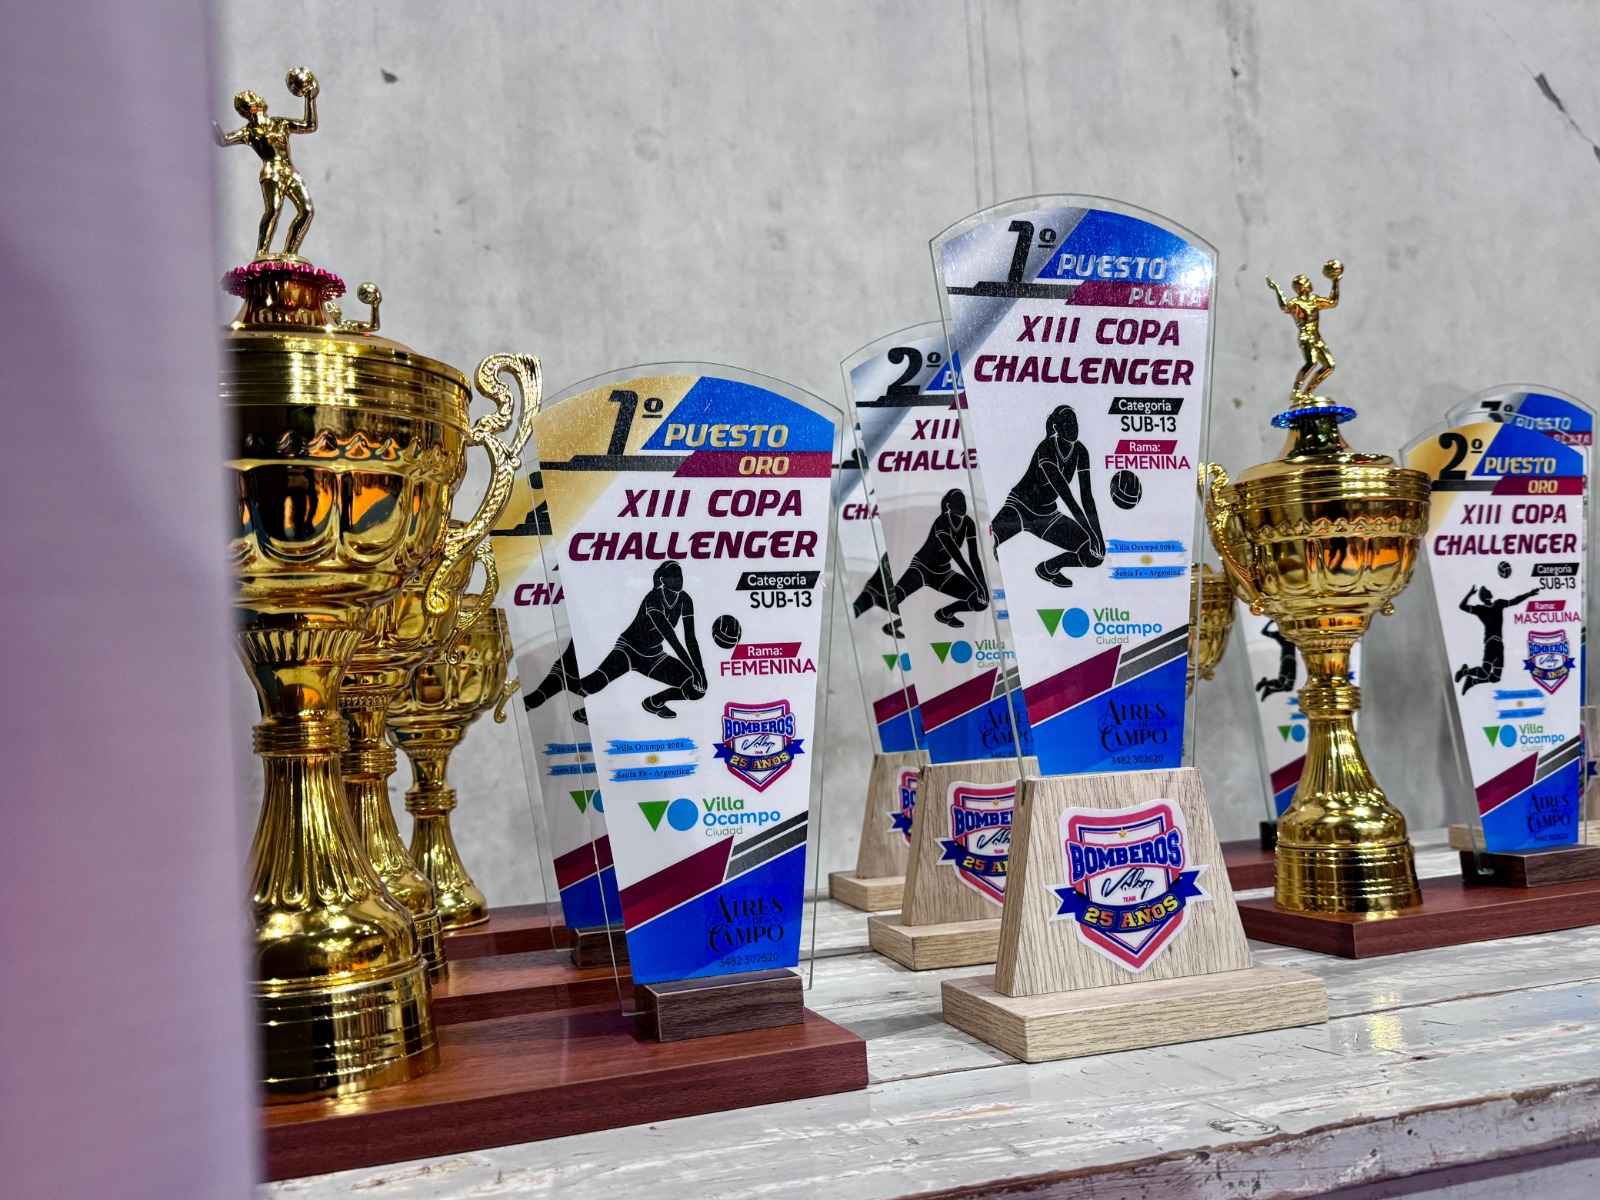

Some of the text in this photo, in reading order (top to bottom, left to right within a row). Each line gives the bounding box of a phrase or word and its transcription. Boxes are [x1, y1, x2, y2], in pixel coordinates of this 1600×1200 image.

[1007, 220, 1057, 283] 1º
[1057, 253, 1168, 280] PUESTO
[1128, 287, 1202, 307] PLATA
[1016, 315, 1180, 346] XIII COPA
[887, 347, 942, 395] 2º
[973, 355, 1194, 385] CHALLENGER
[1118, 399, 1171, 414] Categoría
[608, 389, 663, 456] 1º
[911, 419, 960, 440] XIII
[1121, 416, 1176, 432] SUB-13
[1516, 417, 1571, 430] PUESTO
[663, 424, 789, 448] PUESTO
[1130, 442, 1160, 453] Rama:
[877, 448, 979, 473] CHALLE
[1105, 455, 1191, 470] FEMENINA
[1439, 432, 1483, 480] 2º
[739, 456, 790, 475] ORO
[1484, 457, 1556, 474] PUESTO
[1528, 480, 1558, 494] ORO
[617, 489, 802, 518] XIII COPA
[1461, 504, 1567, 524] XIII COPA
[568, 530, 818, 561] CHALLENGER
[1131, 543, 1158, 551] Ocampo
[1434, 534, 1577, 556] CHALLENGER
[1149, 569, 1181, 577] Argentina
[1537, 565, 1572, 575] Categoría
[747, 573, 806, 589] Categoría
[1539, 577, 1576, 590] SUB-13
[750, 590, 812, 609] SUB-13
[1093, 607, 1130, 622] Villa
[1514, 612, 1581, 624] MASCULINA
[1094, 622, 1162, 637] Ocampo
[1096, 636, 1129, 645] Ciudad
[747, 646, 782, 657] Rama:
[976, 650, 1017, 661] Ocam
[1529, 641, 1569, 657] BOMBEROS
[720, 658, 817, 676] FEMENINA
[1099, 697, 1166, 727] AIRES
[724, 715, 794, 740] BOMBEROS
[1519, 724, 1543, 734] Villa
[1101, 726, 1167, 752] CAMPO
[1520, 733, 1565, 745] Ocampo
[635, 743, 665, 753] Ocampo
[730, 756, 748, 767] 25
[1111, 754, 1164, 765] 3482 302620
[616, 771, 637, 779] Santa
[654, 768, 690, 778] Argentina
[703, 797, 744, 812] Villa
[703, 810, 781, 826] Ocampo
[953, 807, 1013, 837] BOMBE
[1527, 812, 1571, 832] CAMPO
[706, 826, 743, 837] Ciudad
[963, 856, 986, 871] 25
[1069, 829, 1182, 882] BOMBEROS
[706, 894, 783, 924] AIRES
[1084, 895, 1180, 929] 25 AÑOS
[708, 923, 784, 953] CAMPO
[720, 952, 779, 967] 3482 302620
